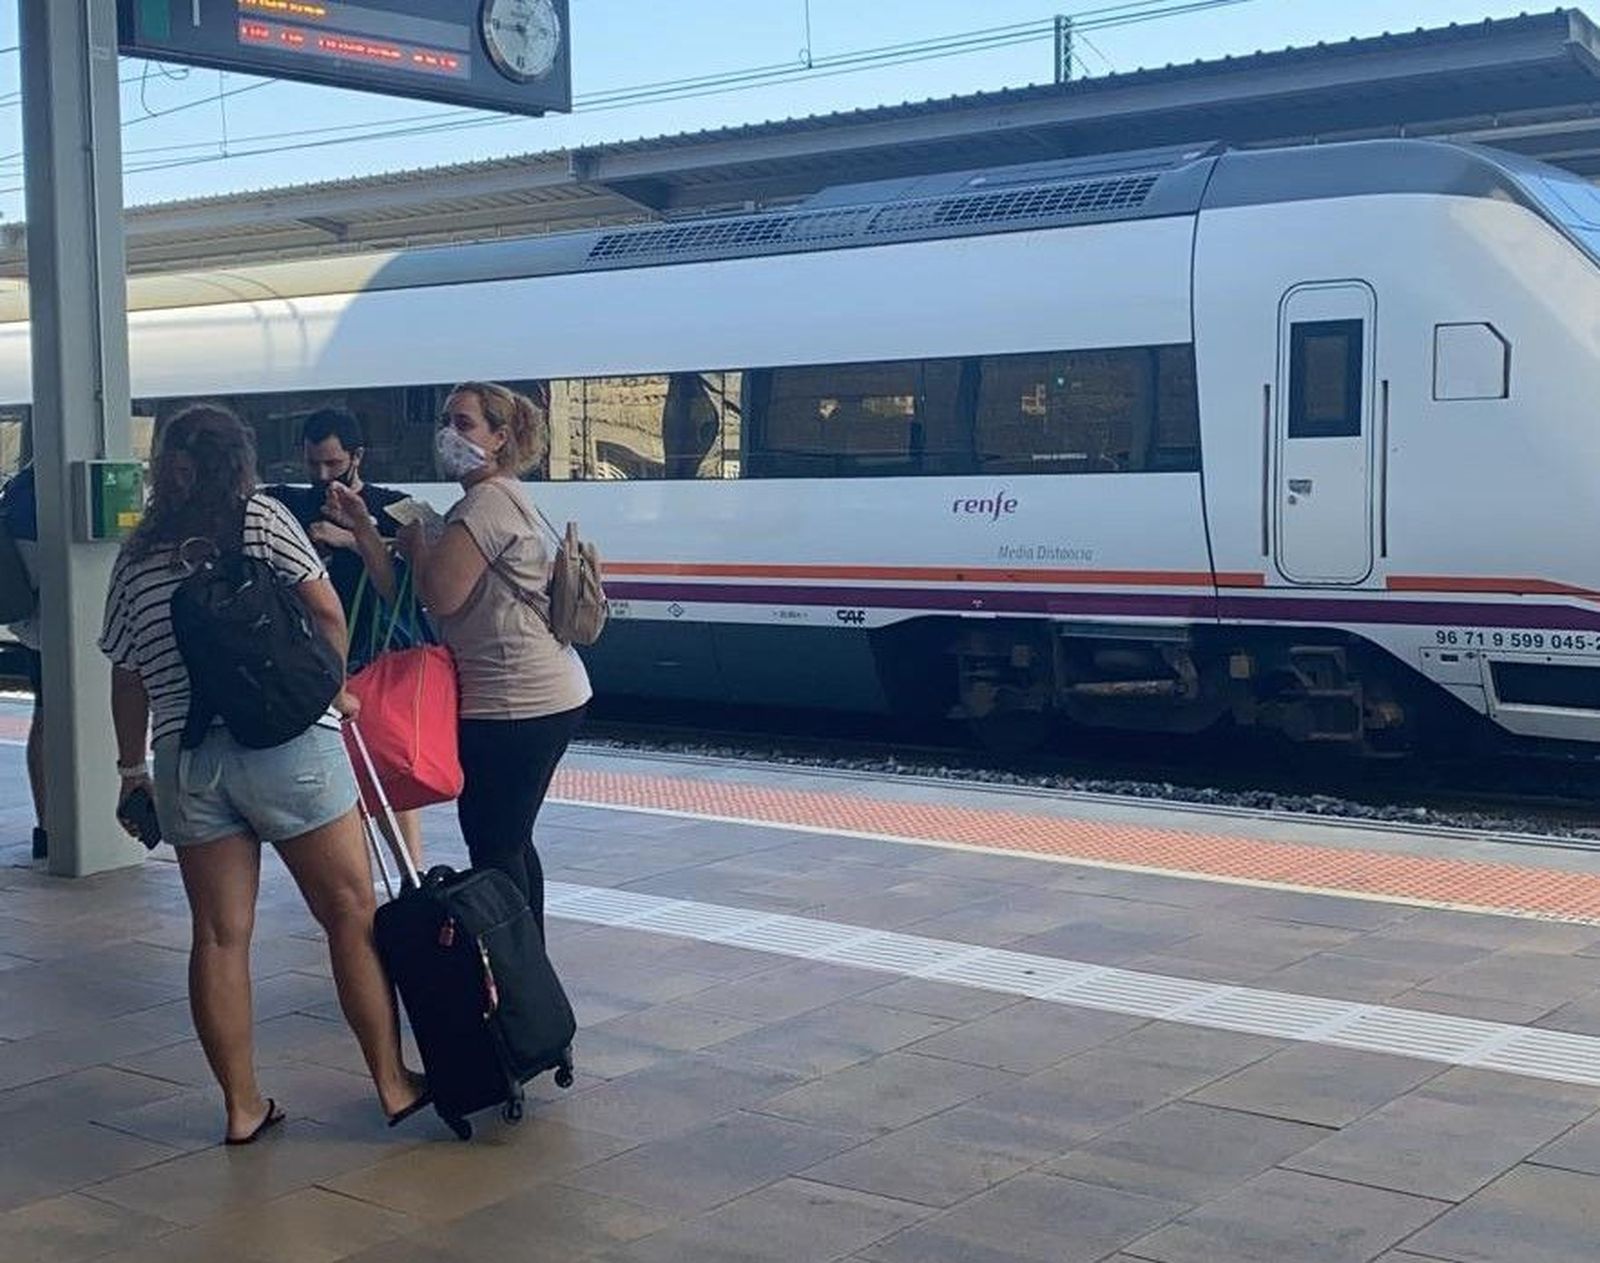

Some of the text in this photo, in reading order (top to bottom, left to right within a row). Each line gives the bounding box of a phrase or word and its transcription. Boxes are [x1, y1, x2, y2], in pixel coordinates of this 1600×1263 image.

[953, 491, 1018, 521] renfe
[1435, 630, 1458, 645] 96
[1464, 631, 1484, 646] 71
[1492, 632, 1503, 647] 9
[1510, 633, 1544, 648] 599
